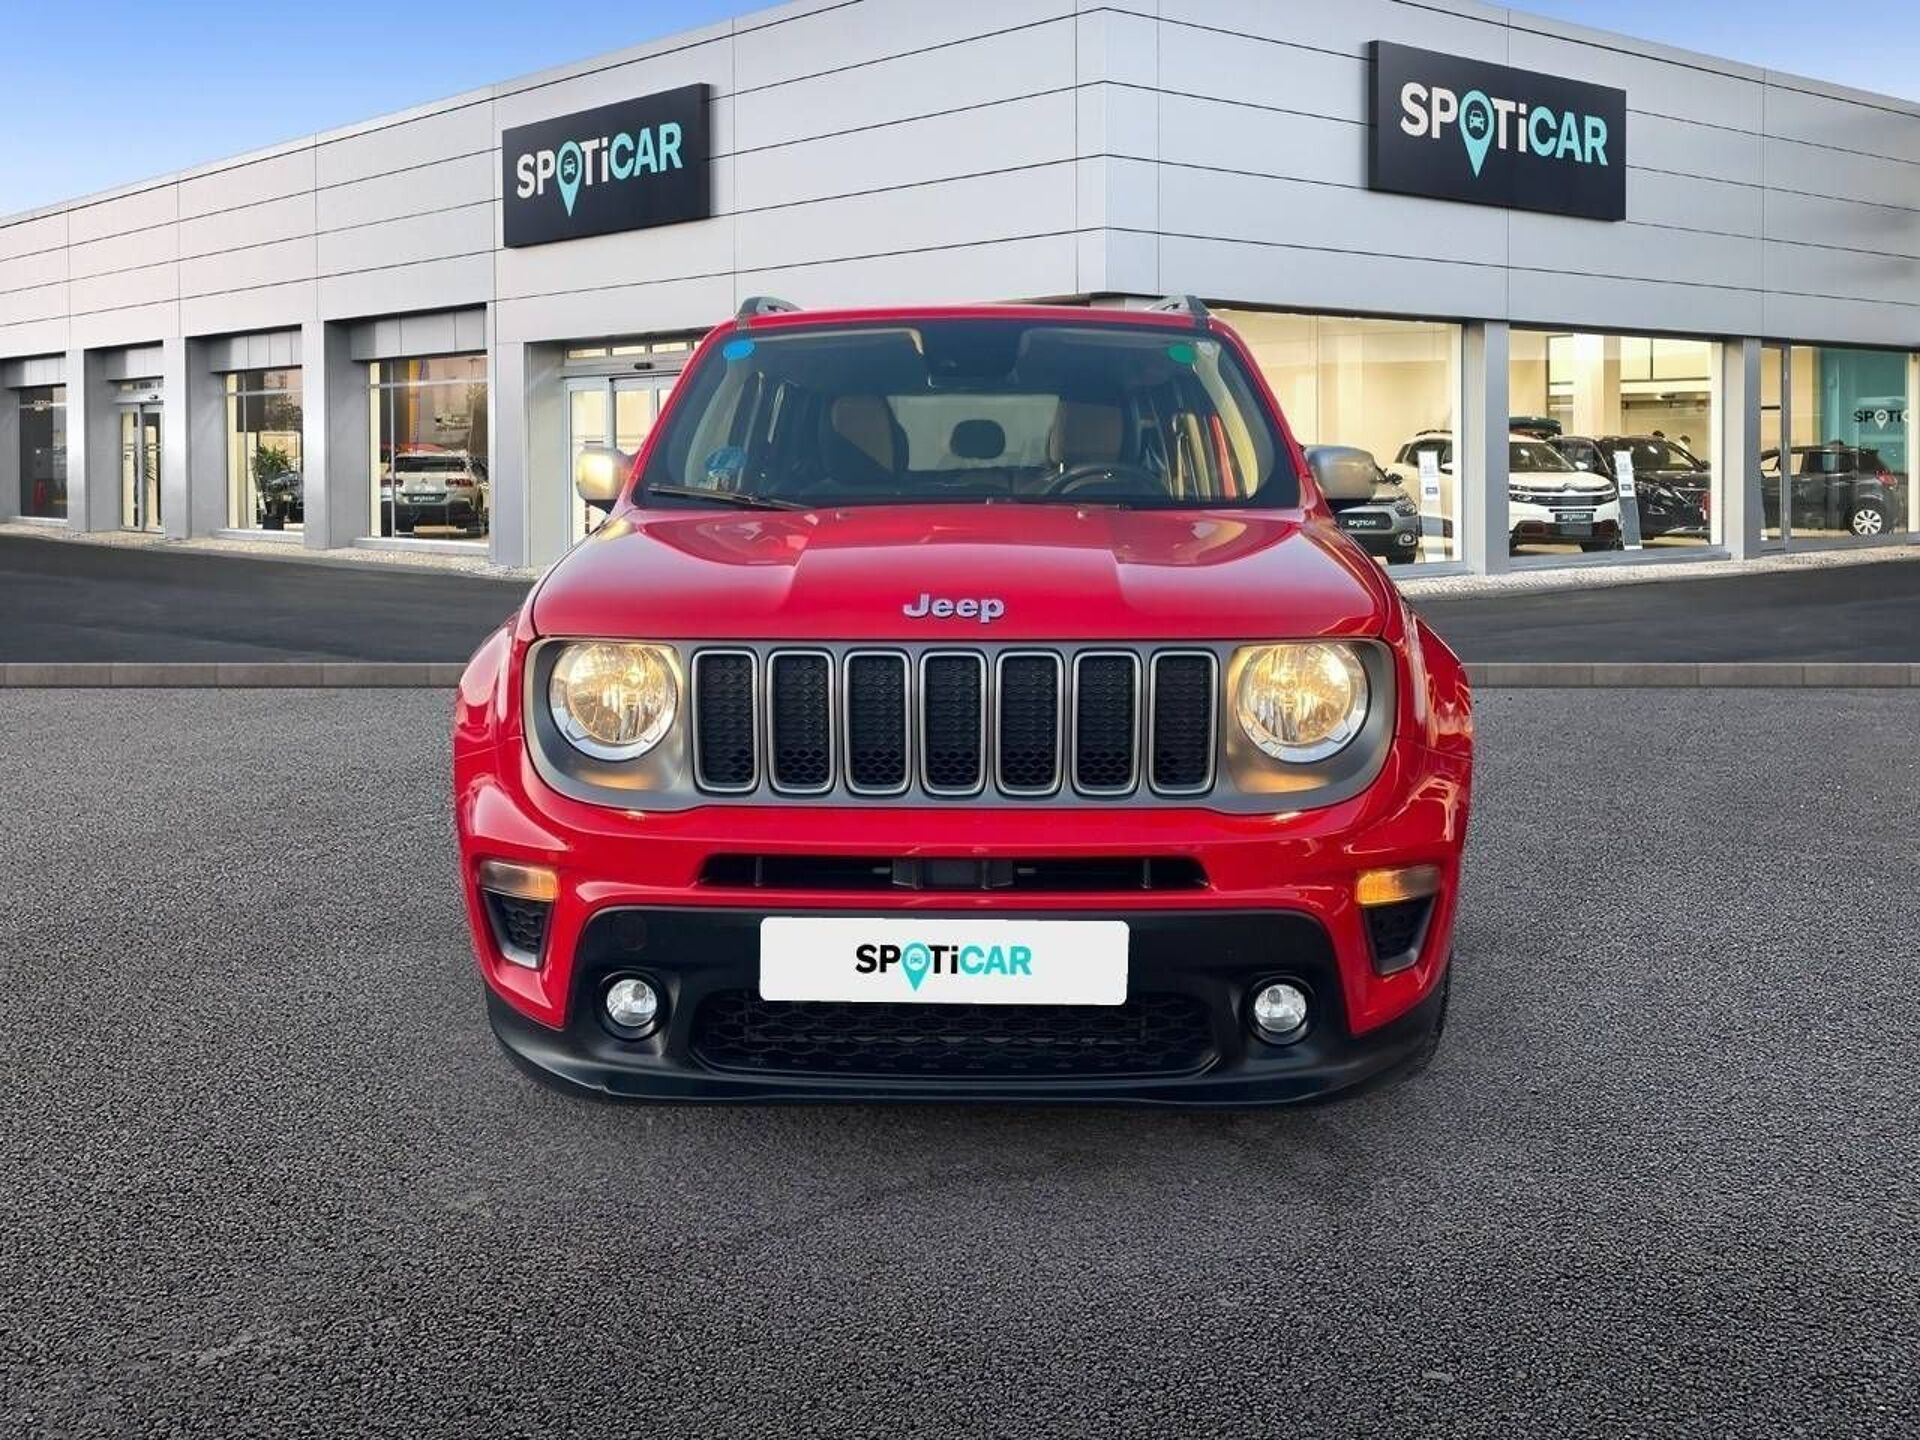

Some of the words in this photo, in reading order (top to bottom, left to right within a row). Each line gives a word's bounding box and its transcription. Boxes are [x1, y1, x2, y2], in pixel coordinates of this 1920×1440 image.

[1400, 81, 1608, 178] SPOTiCAR
[516, 122, 684, 217] SPOTiCAR
[903, 593, 1004, 623] Jeep
[855, 942, 1032, 992] SPOTiCAR
